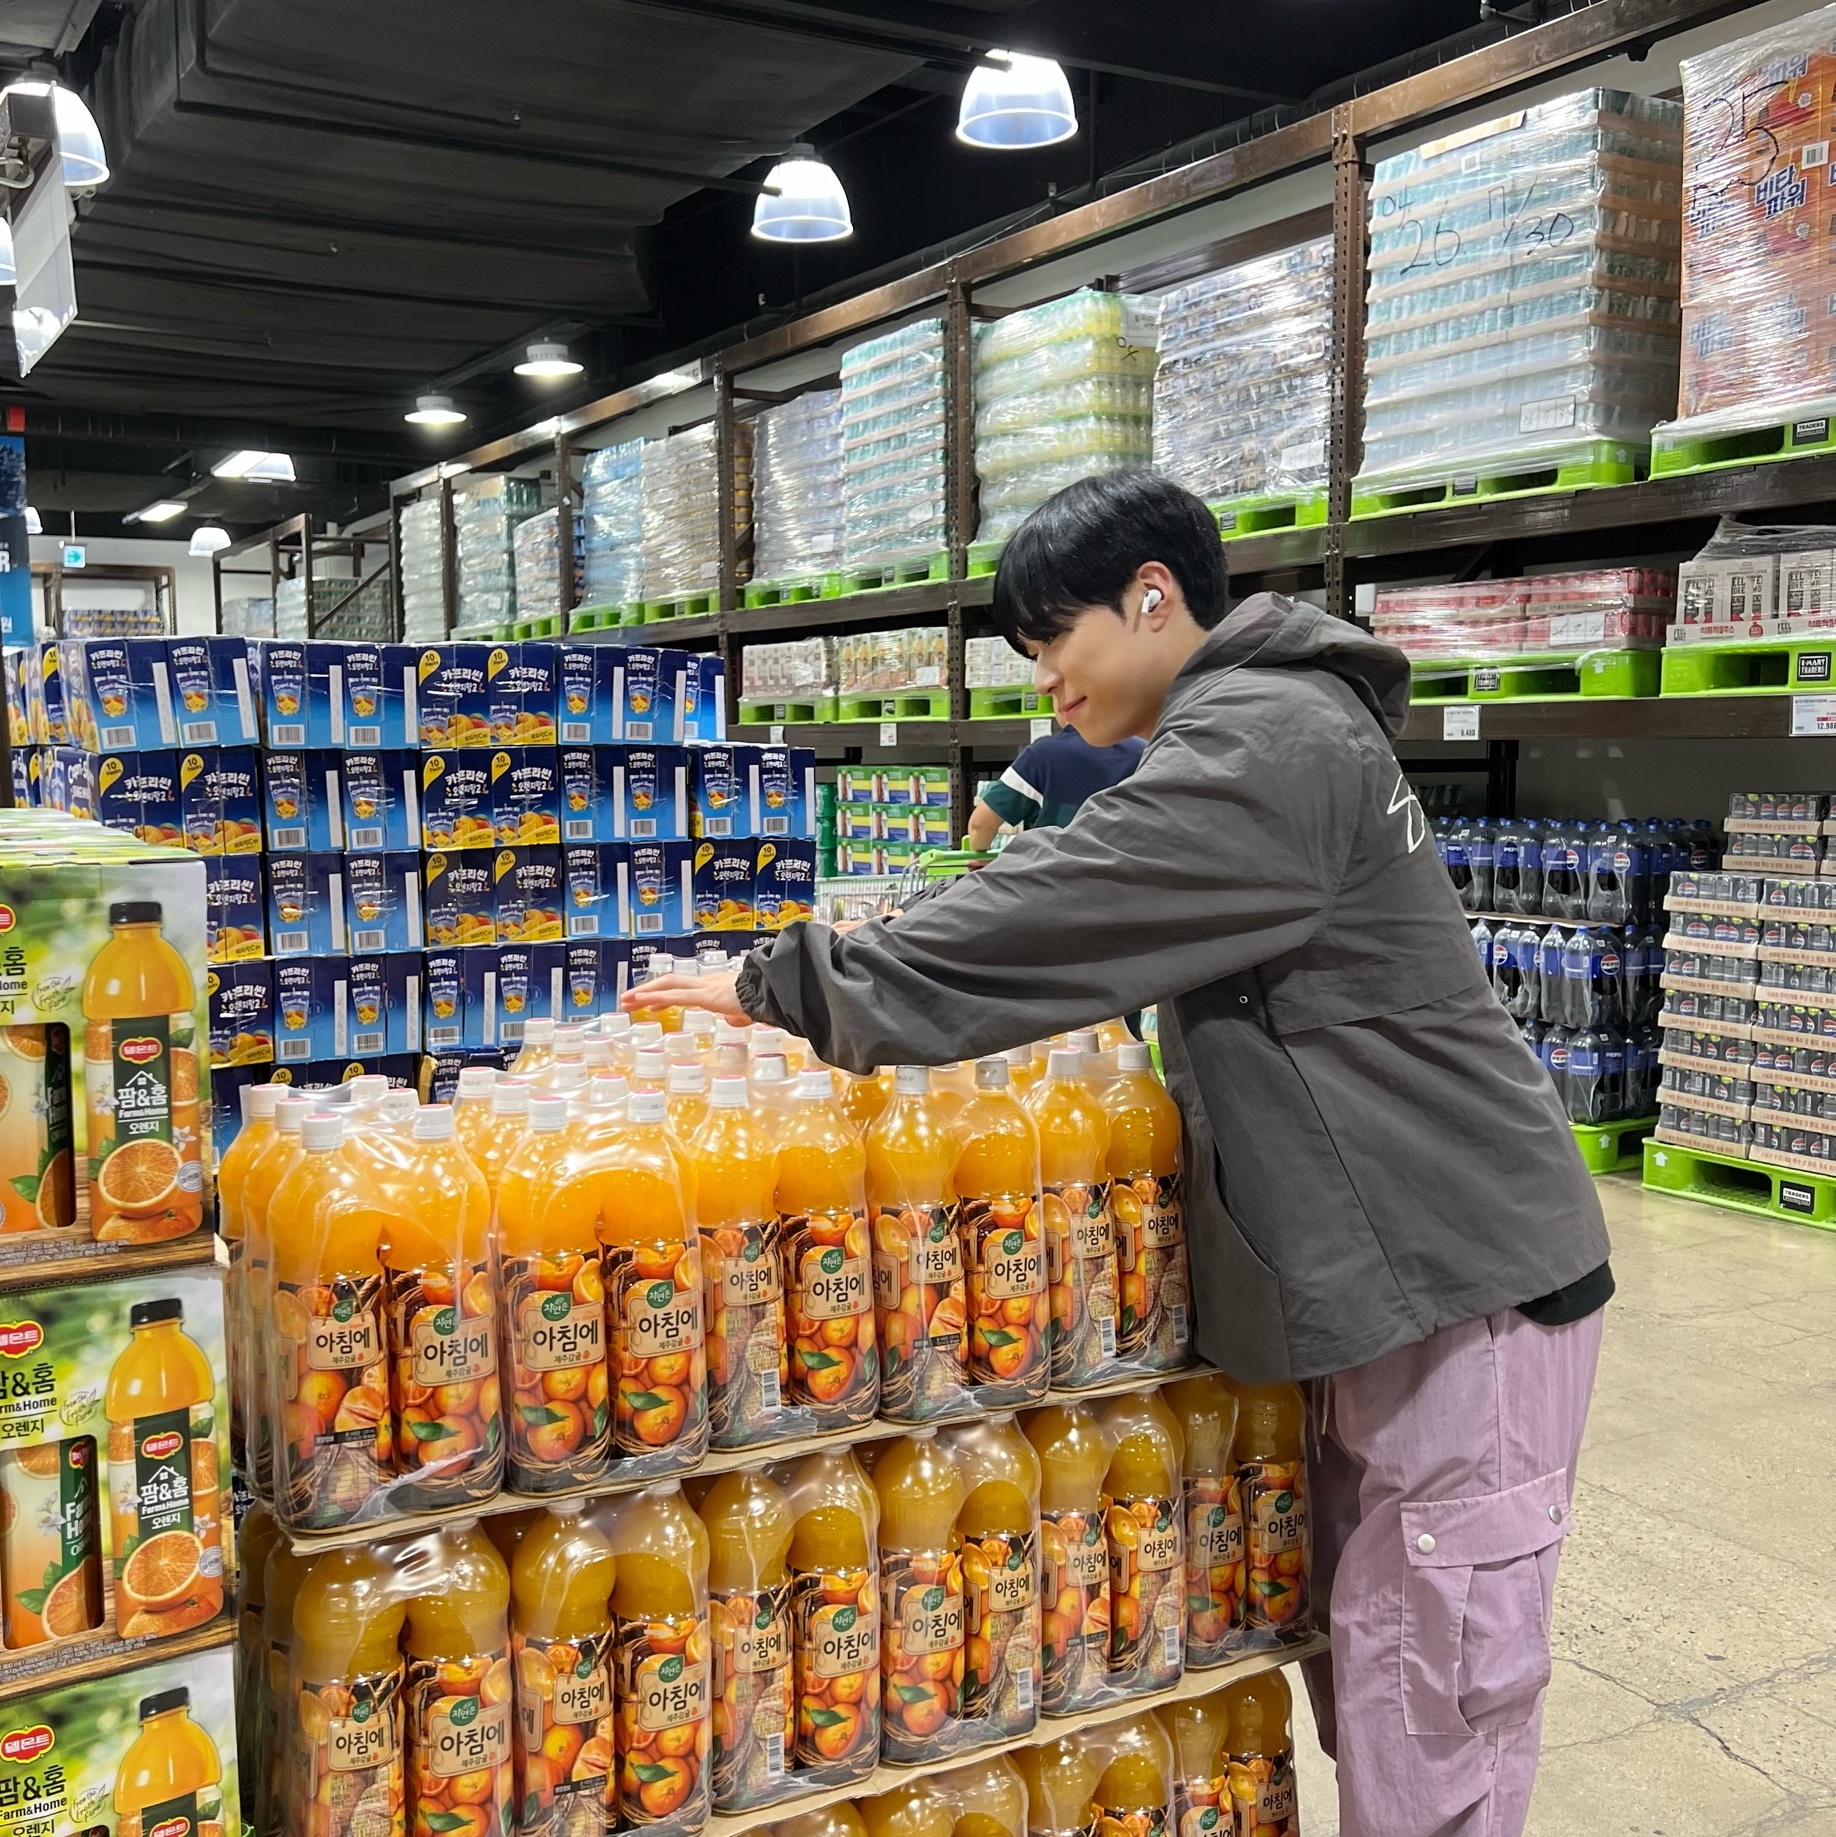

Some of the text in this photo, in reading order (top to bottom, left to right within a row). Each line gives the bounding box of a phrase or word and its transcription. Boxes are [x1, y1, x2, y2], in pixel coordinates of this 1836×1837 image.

[1757, 165, 1796, 205] 비타
[1766, 178, 1807, 219] 파워
[1798, 422, 1825, 432] TRADERS
[425, 653, 435, 662] 10
[106, 761, 117, 770] 10
[188, 756, 199, 767] 10
[429, 759, 439, 768] 10
[433, 856, 443, 865] 10
[501, 853, 511, 862] 10
[123, 1044, 158, 1055] 델몬트
[117, 1083, 168, 1110] 팜&홈
[128, 1121, 160, 1136] 오렌지
[1784, 1189, 1810, 1200] TRADERS
[1077, 1223, 1110, 1246] 아침에
[1148, 1213, 1178, 1237] 아침에
[822, 1256, 841, 1268] 자연은
[916, 1249, 957, 1273] 아침에
[995, 1253, 1042, 1283] 아침에
[730, 1266, 772, 1292] 아침에
[813, 1273, 864, 1303] 아침에
[649, 1288, 671, 1302] 자연은
[544, 1301, 569, 1316] 자연은
[533, 1319, 598, 1352] 아침에
[638, 1310, 698, 1339] 아침에
[316, 1327, 370, 1354] 아침에
[424, 1332, 489, 1368] 아침에
[1, 1418, 44, 1441] 오렌지
[145, 1437, 179, 1453] 델몬트
[141, 1475, 189, 1506] 팜&홈
[152, 1513, 181, 1530] 오렌지
[1144, 1537, 1177, 1559] 아침에
[1199, 1526, 1243, 1554] 아침에
[1073, 1552, 1106, 1574] 아침에
[995, 1574, 1030, 1599] 아침에
[912, 1610, 963, 1638] 아침에
[741, 1634, 782, 1659] 아침에
[823, 1628, 876, 1661] 아침에
[660, 1665, 681, 1678] 자연은
[561, 1681, 604, 1709] 아침에
[649, 1680, 706, 1713] 아침에
[452, 1704, 476, 1720] 자연은
[5, 1734, 50, 1754] 델몬트
[336, 1727, 384, 1756] 아침에
[440, 1719, 505, 1758] 아침에
[1263, 1786, 1292, 1811] 아침에
